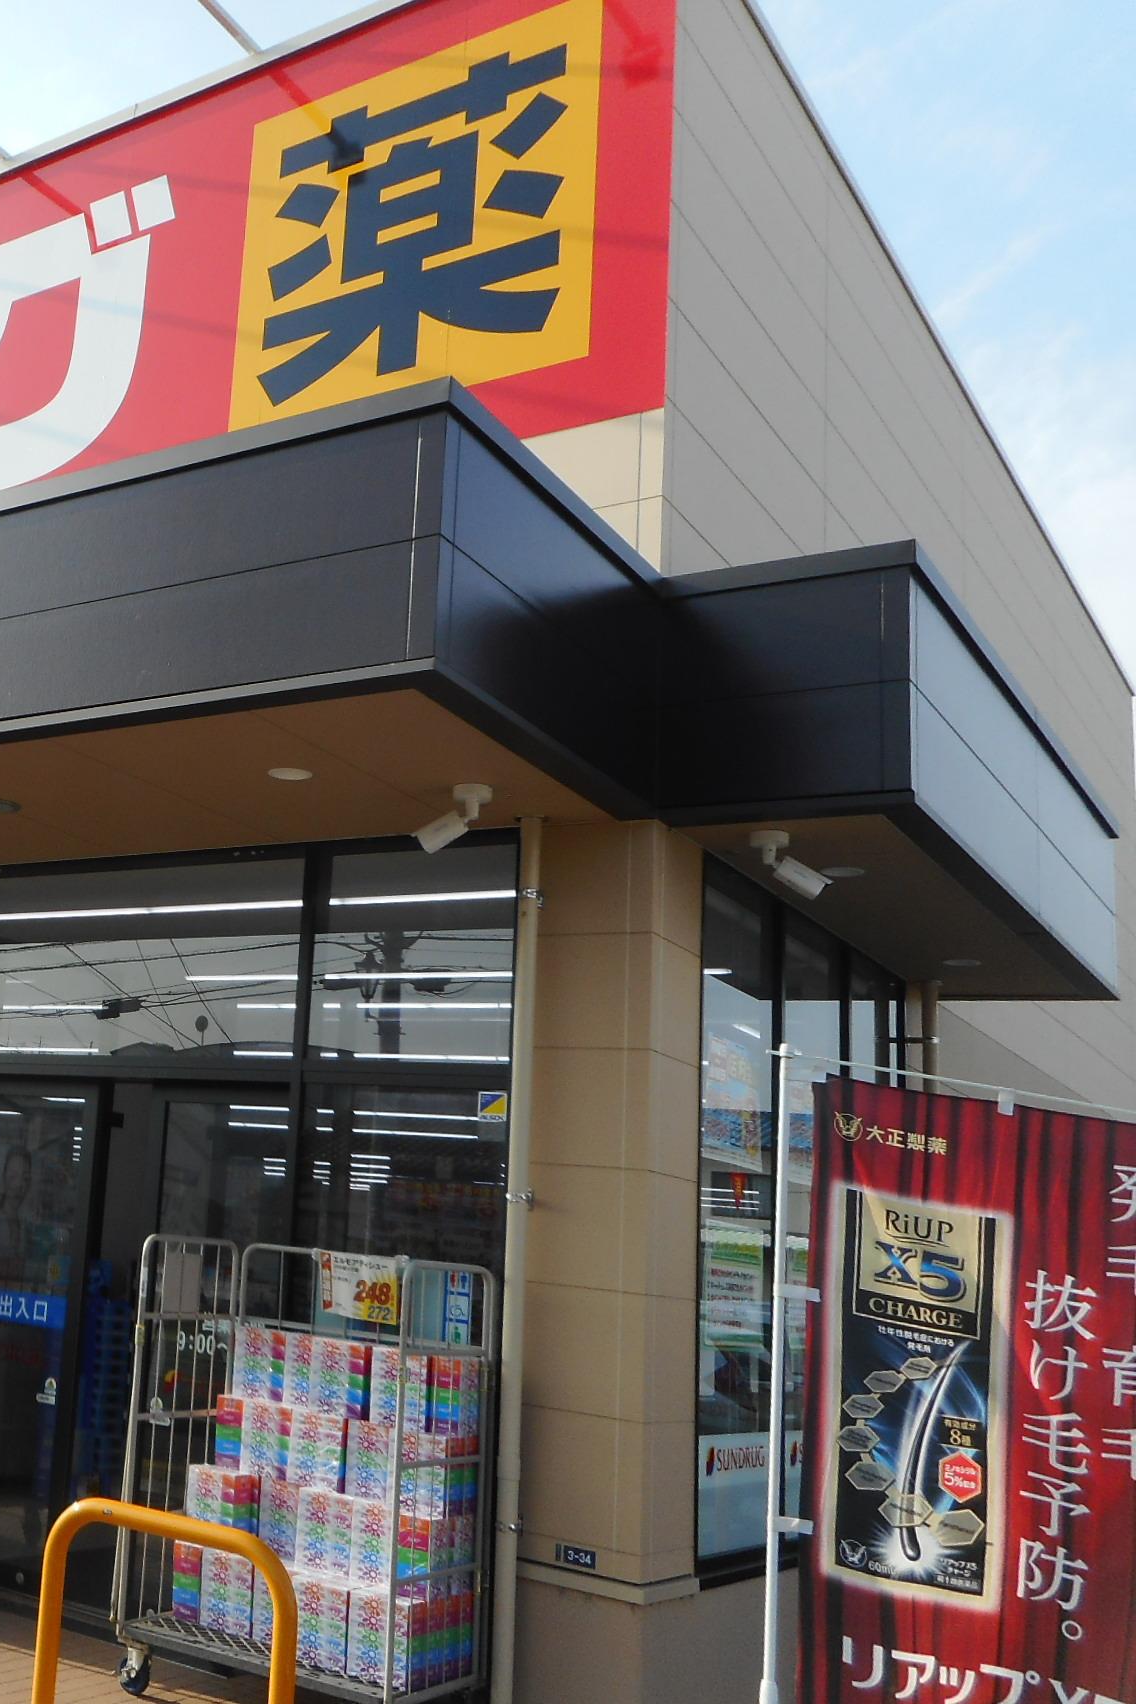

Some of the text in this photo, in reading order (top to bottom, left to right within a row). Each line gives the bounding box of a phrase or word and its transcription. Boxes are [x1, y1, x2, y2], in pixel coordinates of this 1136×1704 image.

[257, 43, 568, 407] 薬
[865, 1125, 948, 1156] 大正製薬
[884, 1208, 954, 1242] RiUP
[873, 1241, 967, 1302] X5
[353, 1279, 392, 1306] 248
[367, 1305, 392, 1321] 272
[868, 1297, 964, 1329] CHARGE
[717, 1446, 765, 1471] SUNDRUG
[567, 1550, 592, 1565] 3-34
